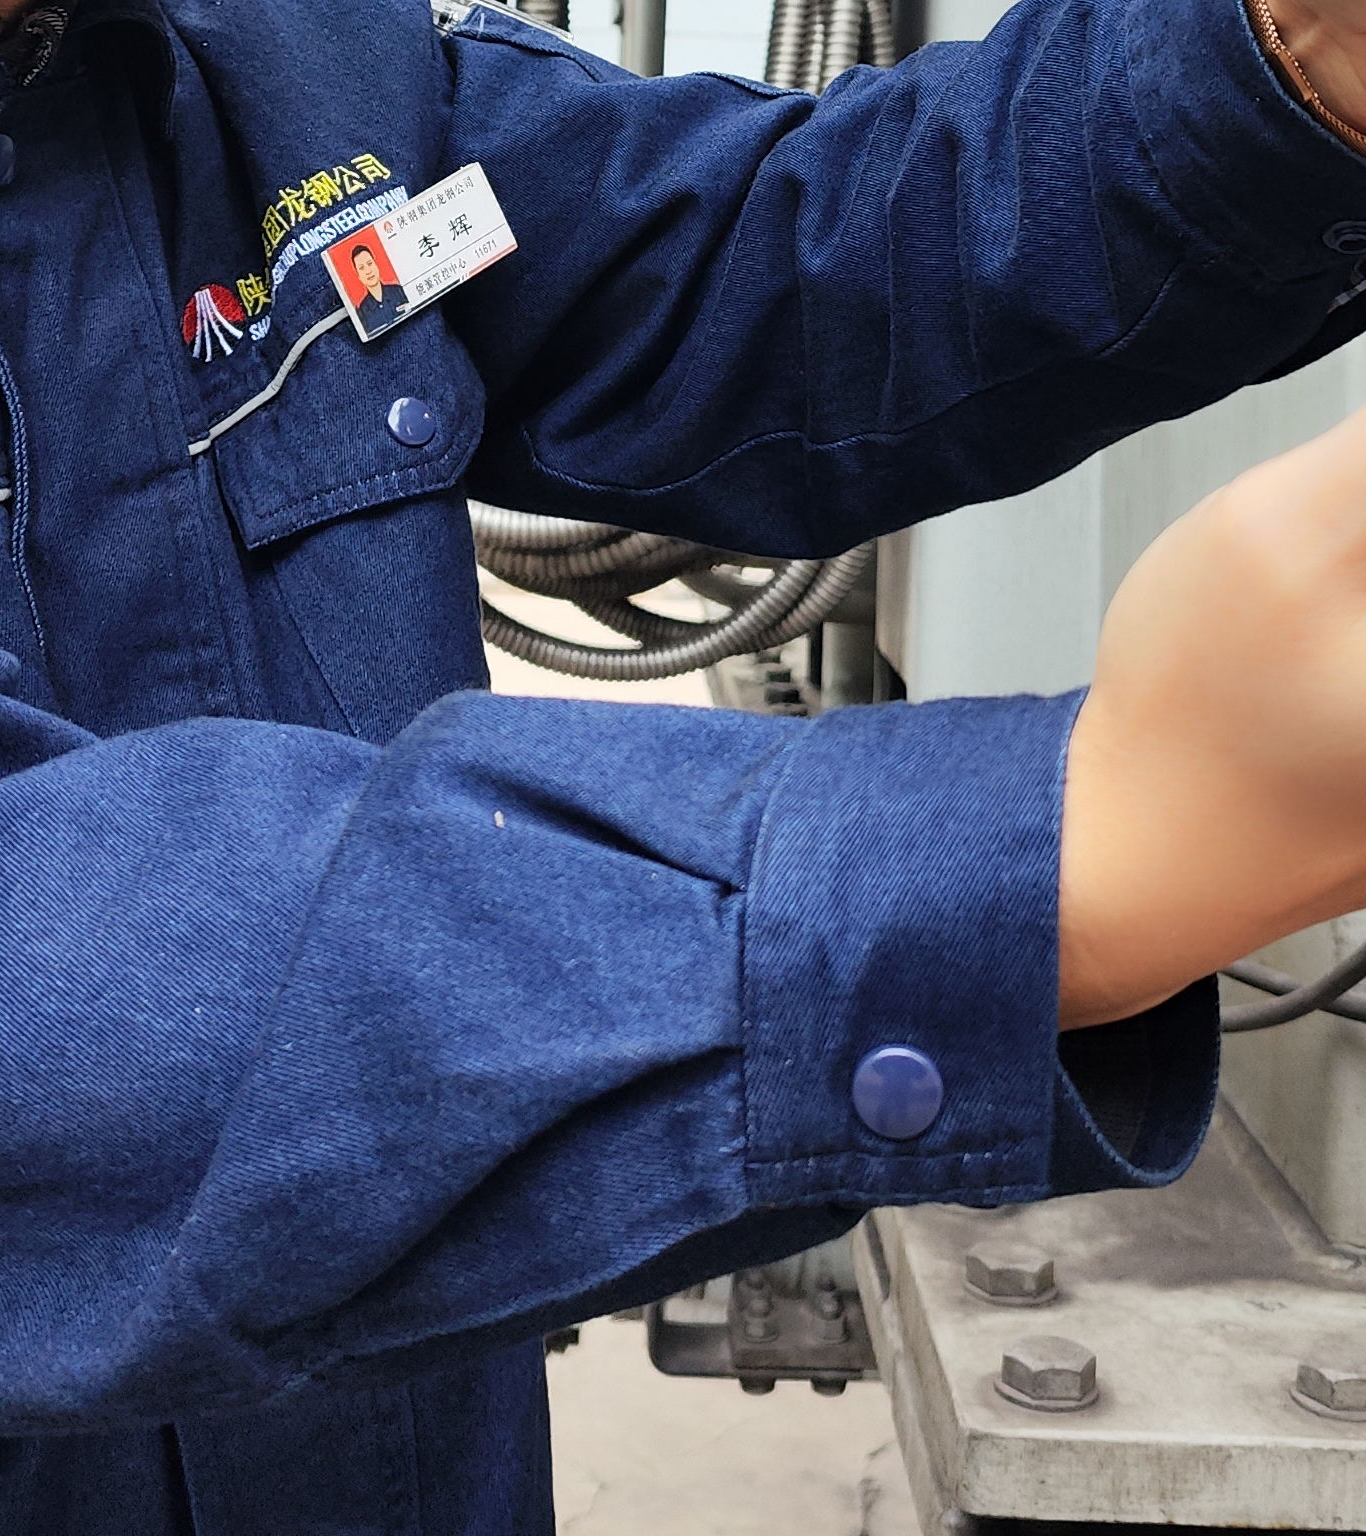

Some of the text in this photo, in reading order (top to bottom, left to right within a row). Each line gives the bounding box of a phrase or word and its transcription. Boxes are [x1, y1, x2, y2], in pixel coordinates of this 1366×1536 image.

[396, 175, 475, 230] 陕钢集团龙钢公司
[474, 238, 498, 259] 11671
